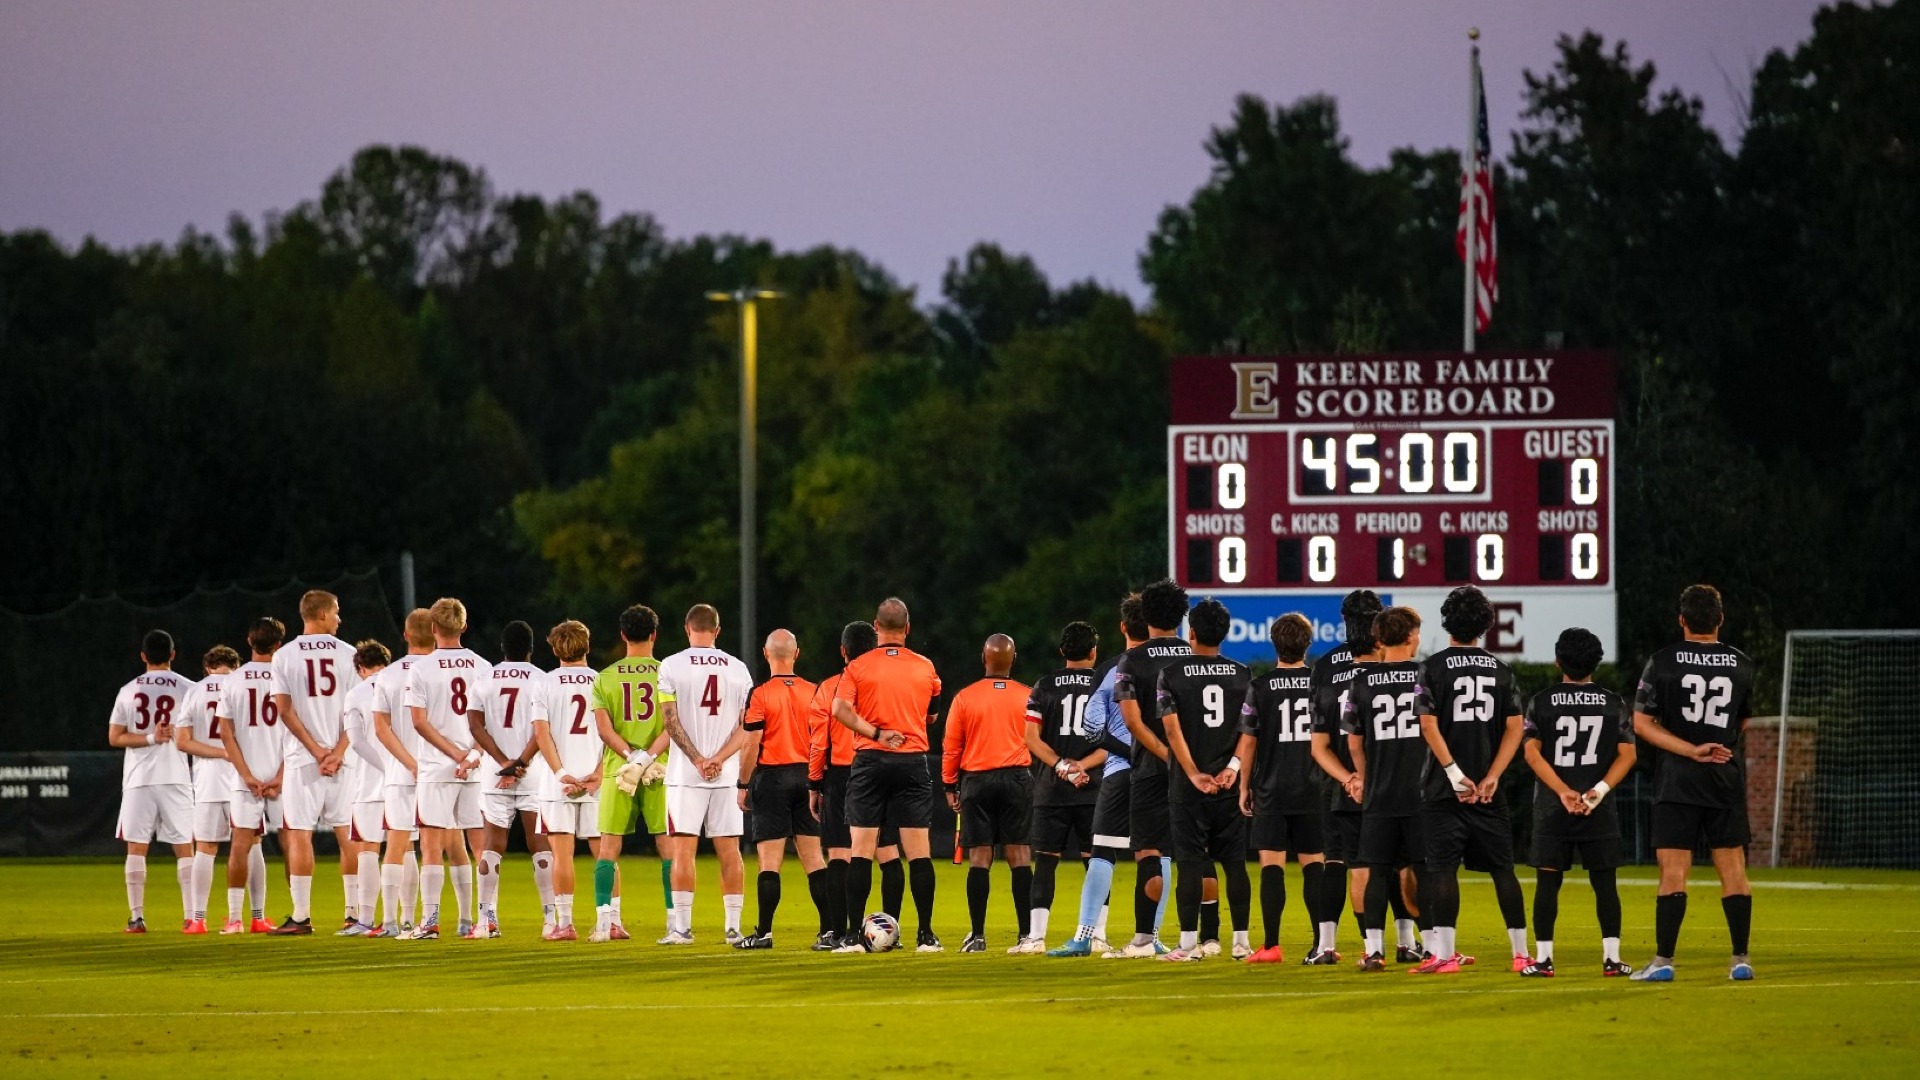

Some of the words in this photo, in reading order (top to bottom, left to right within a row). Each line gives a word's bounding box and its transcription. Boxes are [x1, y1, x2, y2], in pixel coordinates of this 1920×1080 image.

[1296, 360, 1423, 386] KEENER
[1435, 358, 1554, 384] FAMILY
[1230, 362, 1279, 420] E
[1296, 387, 1555, 417] SCOREBOARD
[1183, 434, 1248, 463] ELON
[1524, 430, 1609, 459] GUEST
[1302, 432, 1478, 494] 45:00
[1218, 463, 1246, 509] 0
[1571, 458, 1598, 505] 0
[1185, 513, 1245, 535] SHOTS
[1271, 513, 1287, 534] C.
[1291, 512, 1340, 534] KICKS
[1355, 512, 1421, 533] PERIOD
[1439, 511, 1456, 533] C.
[1460, 511, 1509, 532] KICKS
[1538, 510, 1598, 531] SHOTS
[1218, 536, 1246, 583] 0
[1308, 535, 1336, 582] 0
[1393, 537, 1404, 579] 1
[1477, 534, 1503, 580] 0
[1571, 533, 1598, 580] 0
[299, 641, 337, 651] ELON
[690, 655, 729, 666] ELON
[1148, 646, 1191, 657] QUAKER
[1446, 655, 1498, 669] QUAKERS
[1676, 651, 1737, 667] QUAKERS
[245, 670, 272, 680] ELO
[304, 658, 337, 697] 15
[438, 658, 475, 669] ELON
[492, 668, 532, 680] ELON
[559, 674, 595, 685] ELON
[617, 664, 659, 674] ELON
[1055, 674, 1091, 687] QUAKE
[1184, 664, 1237, 677] QUAKERS
[136, 677, 177, 688] ELON
[451, 676, 468, 716] 8
[699, 674, 723, 716] 4
[1453, 675, 1496, 722] 25
[1551, 691, 1607, 706] QUAKERS
[134, 692, 175, 730] 38
[246, 687, 278, 727] 16
[500, 687, 520, 728] 7
[569, 694, 588, 735] 2
[620, 681, 655, 722] 13
[1202, 684, 1225, 728] 9
[1372, 692, 1420, 741] 22
[1681, 673, 1733, 728] 32
[1278, 698, 1312, 742] 12
[1554, 715, 1604, 767] 27
